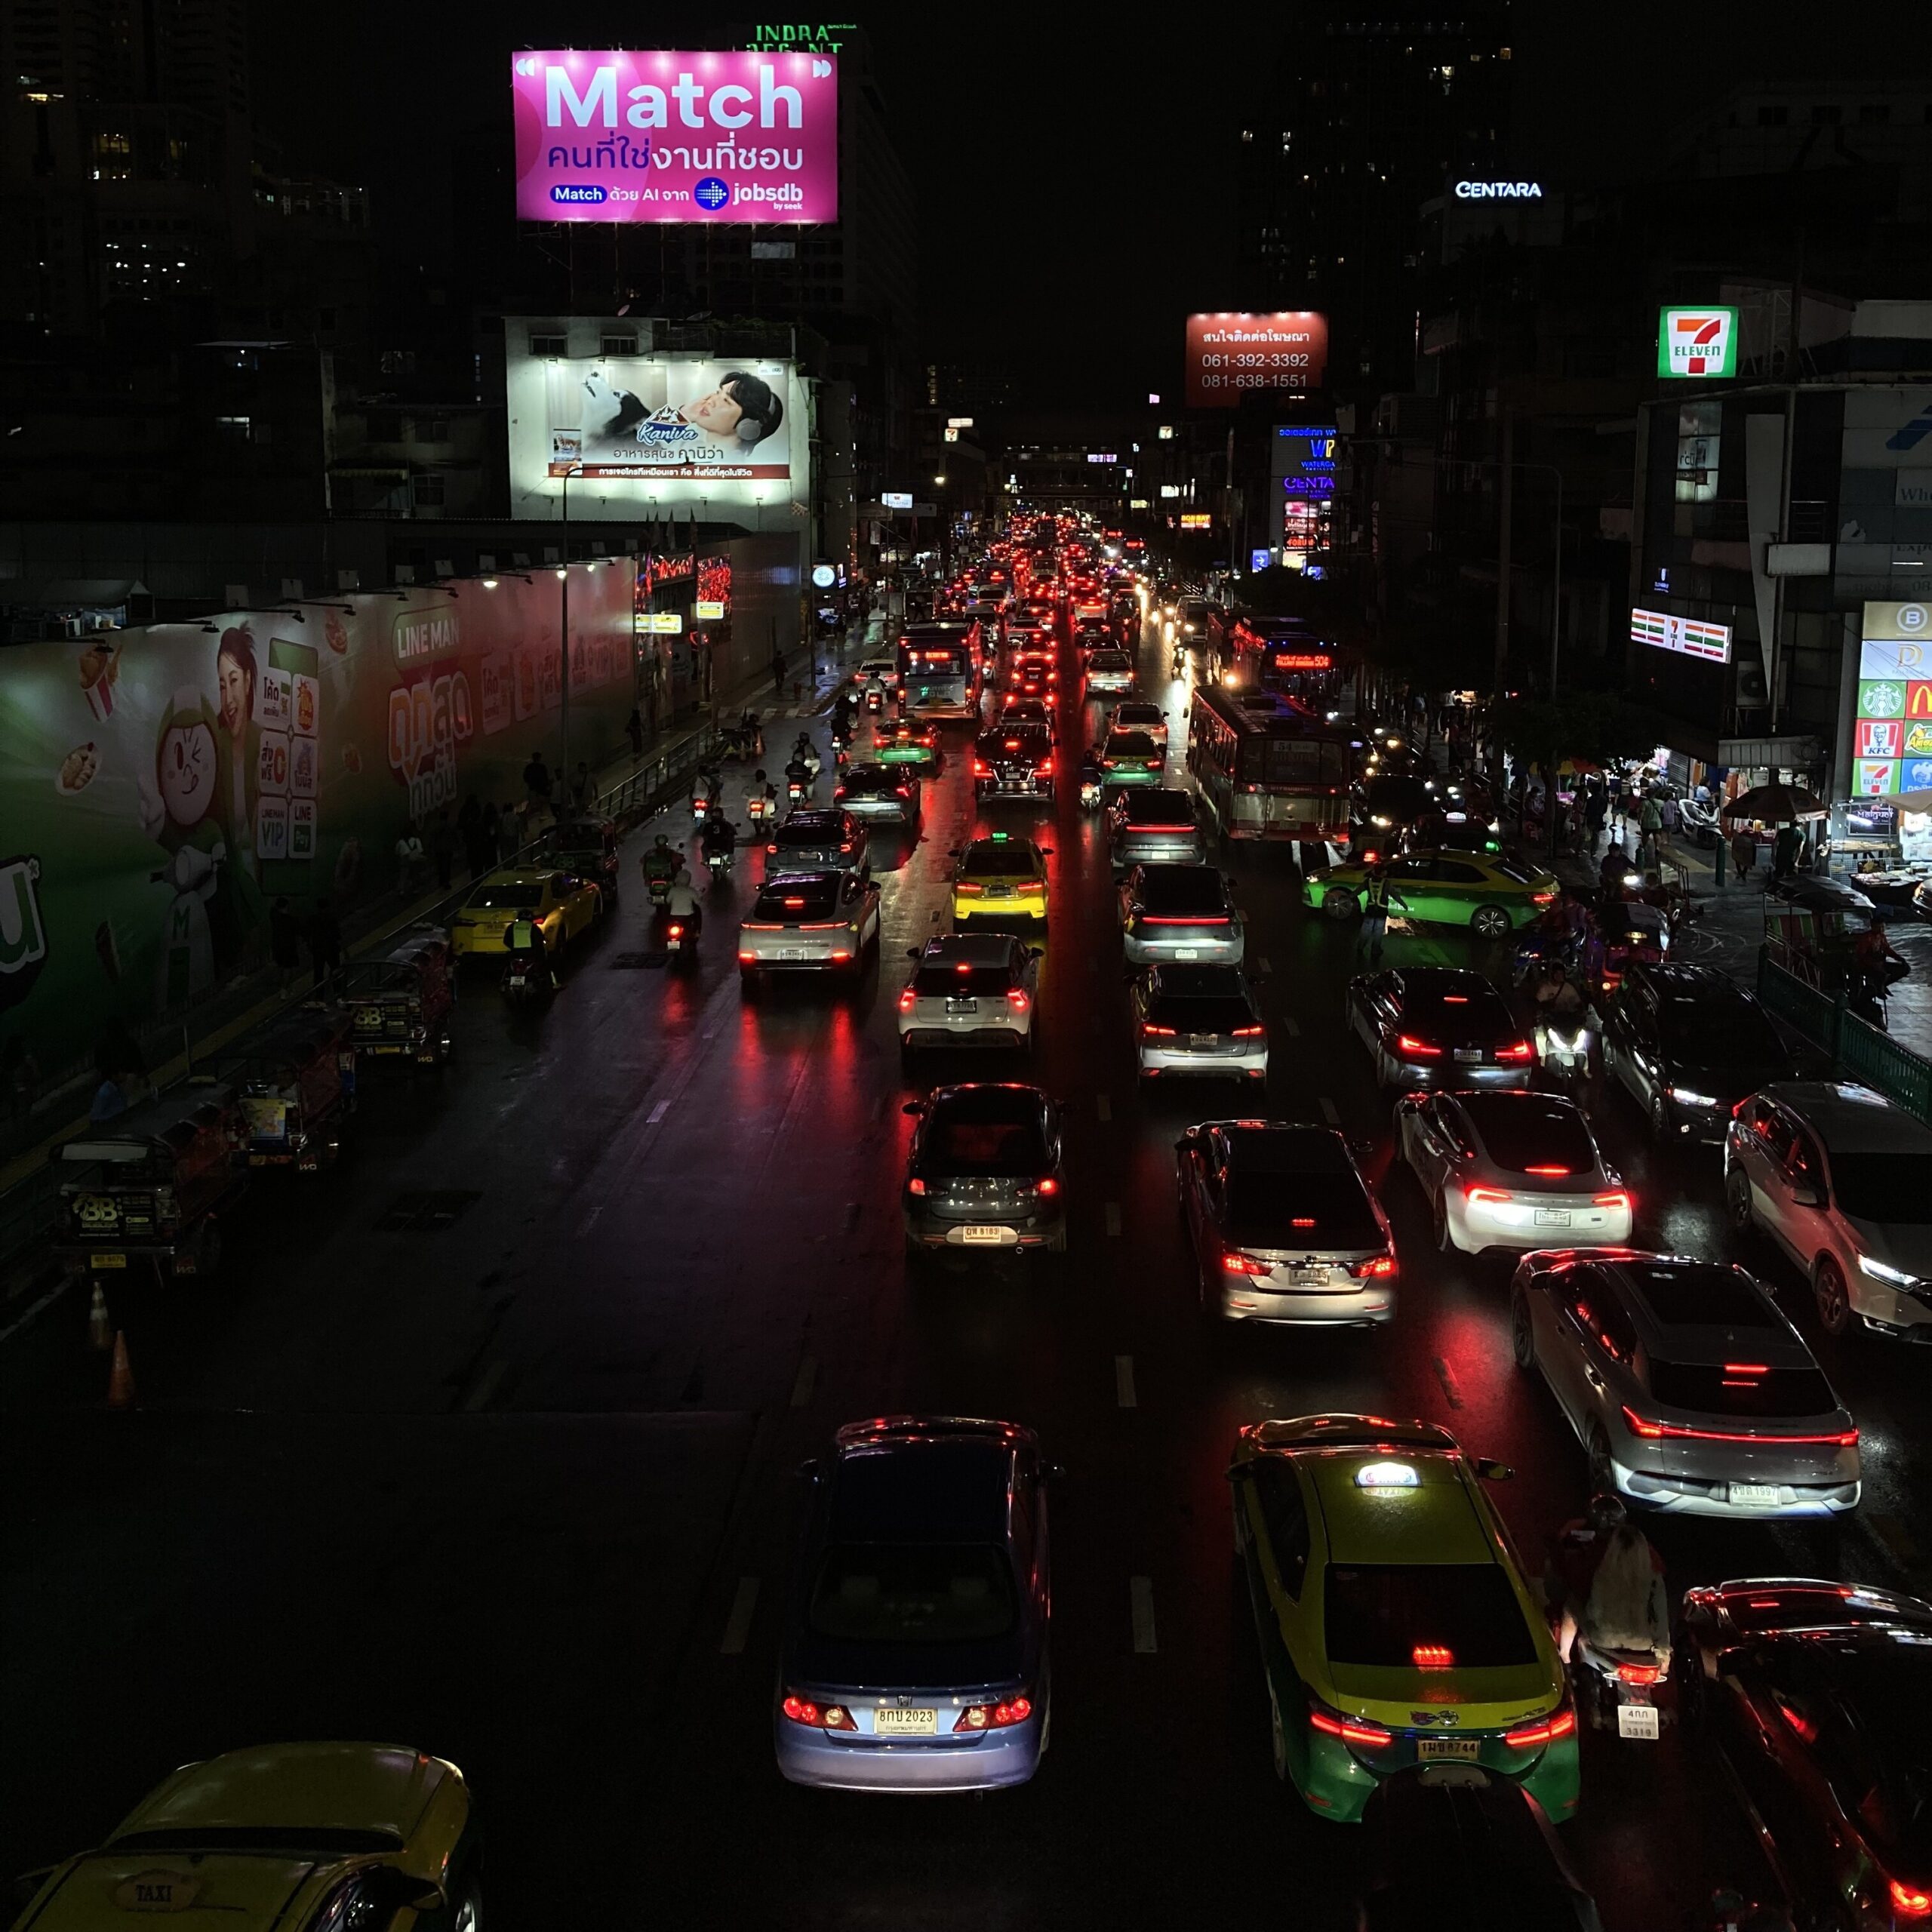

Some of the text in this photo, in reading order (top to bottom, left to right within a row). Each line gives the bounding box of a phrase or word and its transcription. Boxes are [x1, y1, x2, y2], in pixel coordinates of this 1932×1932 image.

[756, 25, 829, 41] INDRA
[545, 64, 803, 128] Match
[555, 186, 689, 201] Match ด้วย AI จาก
[732, 183, 803, 205] jobsdb
[1455, 181, 1542, 198] CENTARA
[774, 202, 803, 211] by seek
[1202, 328, 1309, 342] สนใจติดต่อโฆษณา
[1201, 353, 1309, 367] 061-392-3392
[1201, 374, 1307, 388] 081-638-1551
[638, 424, 699, 445] Kaniva
[614, 445, 724, 462] อาหารสุนัข คานิว่า
[1284, 476, 1335, 489] CENTA
[397, 617, 460, 659] LINE MAN
[294, 805, 312, 821] LINE
[262, 820, 285, 847] VIP
[906, 1710, 933, 1722] 2023
[1628, 1710, 1648, 1718] 4กก
[136, 1884, 172, 1902] TAXI
